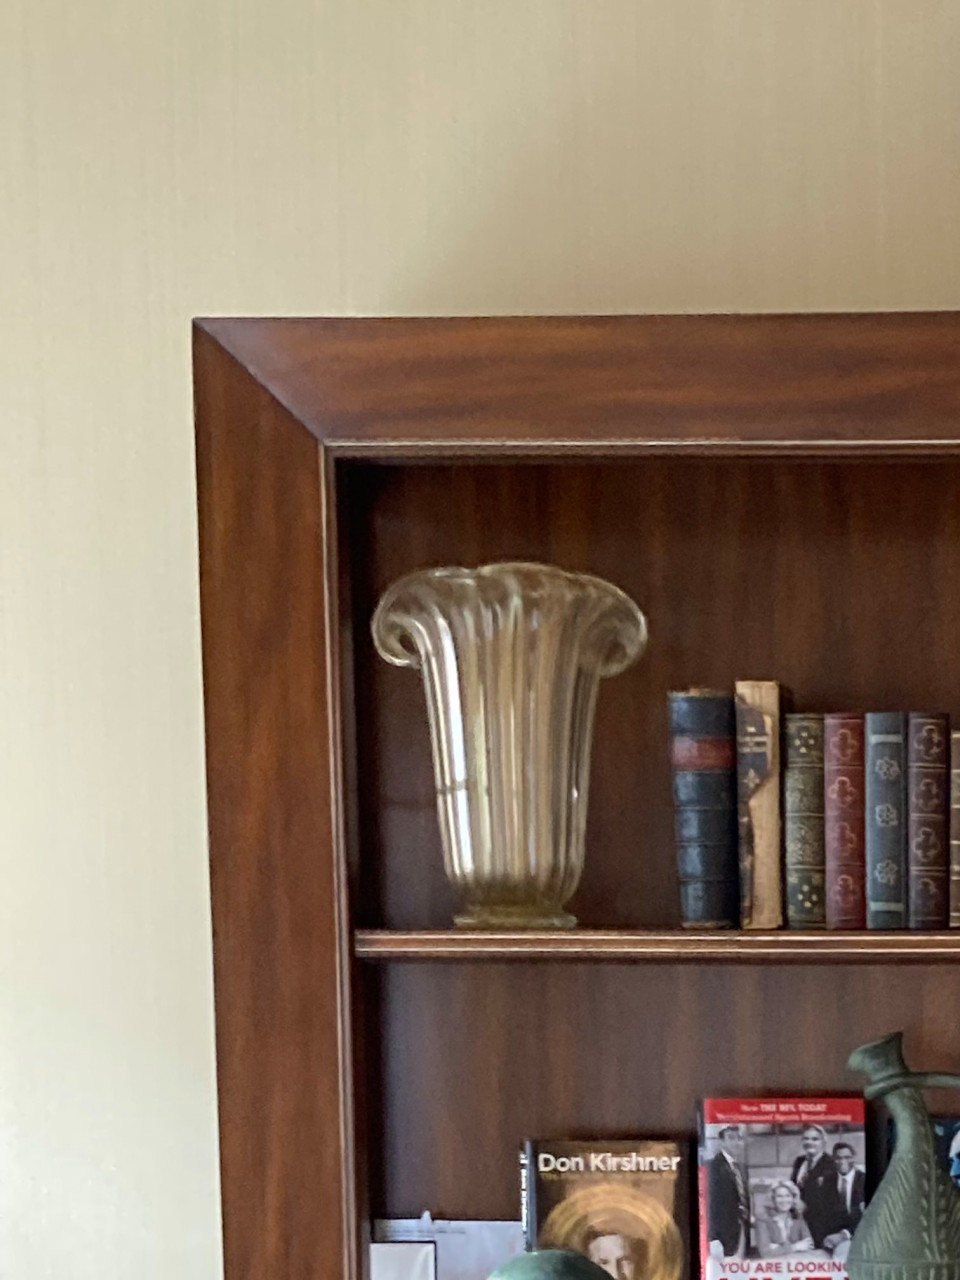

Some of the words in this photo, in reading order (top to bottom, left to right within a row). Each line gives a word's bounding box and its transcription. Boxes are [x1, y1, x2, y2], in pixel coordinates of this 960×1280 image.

[538, 1153, 585, 1172] Don
[590, 1152, 681, 1172] Kirshner
[719, 1262, 750, 1274] YOU
[754, 1262, 783, 1273] ARE
